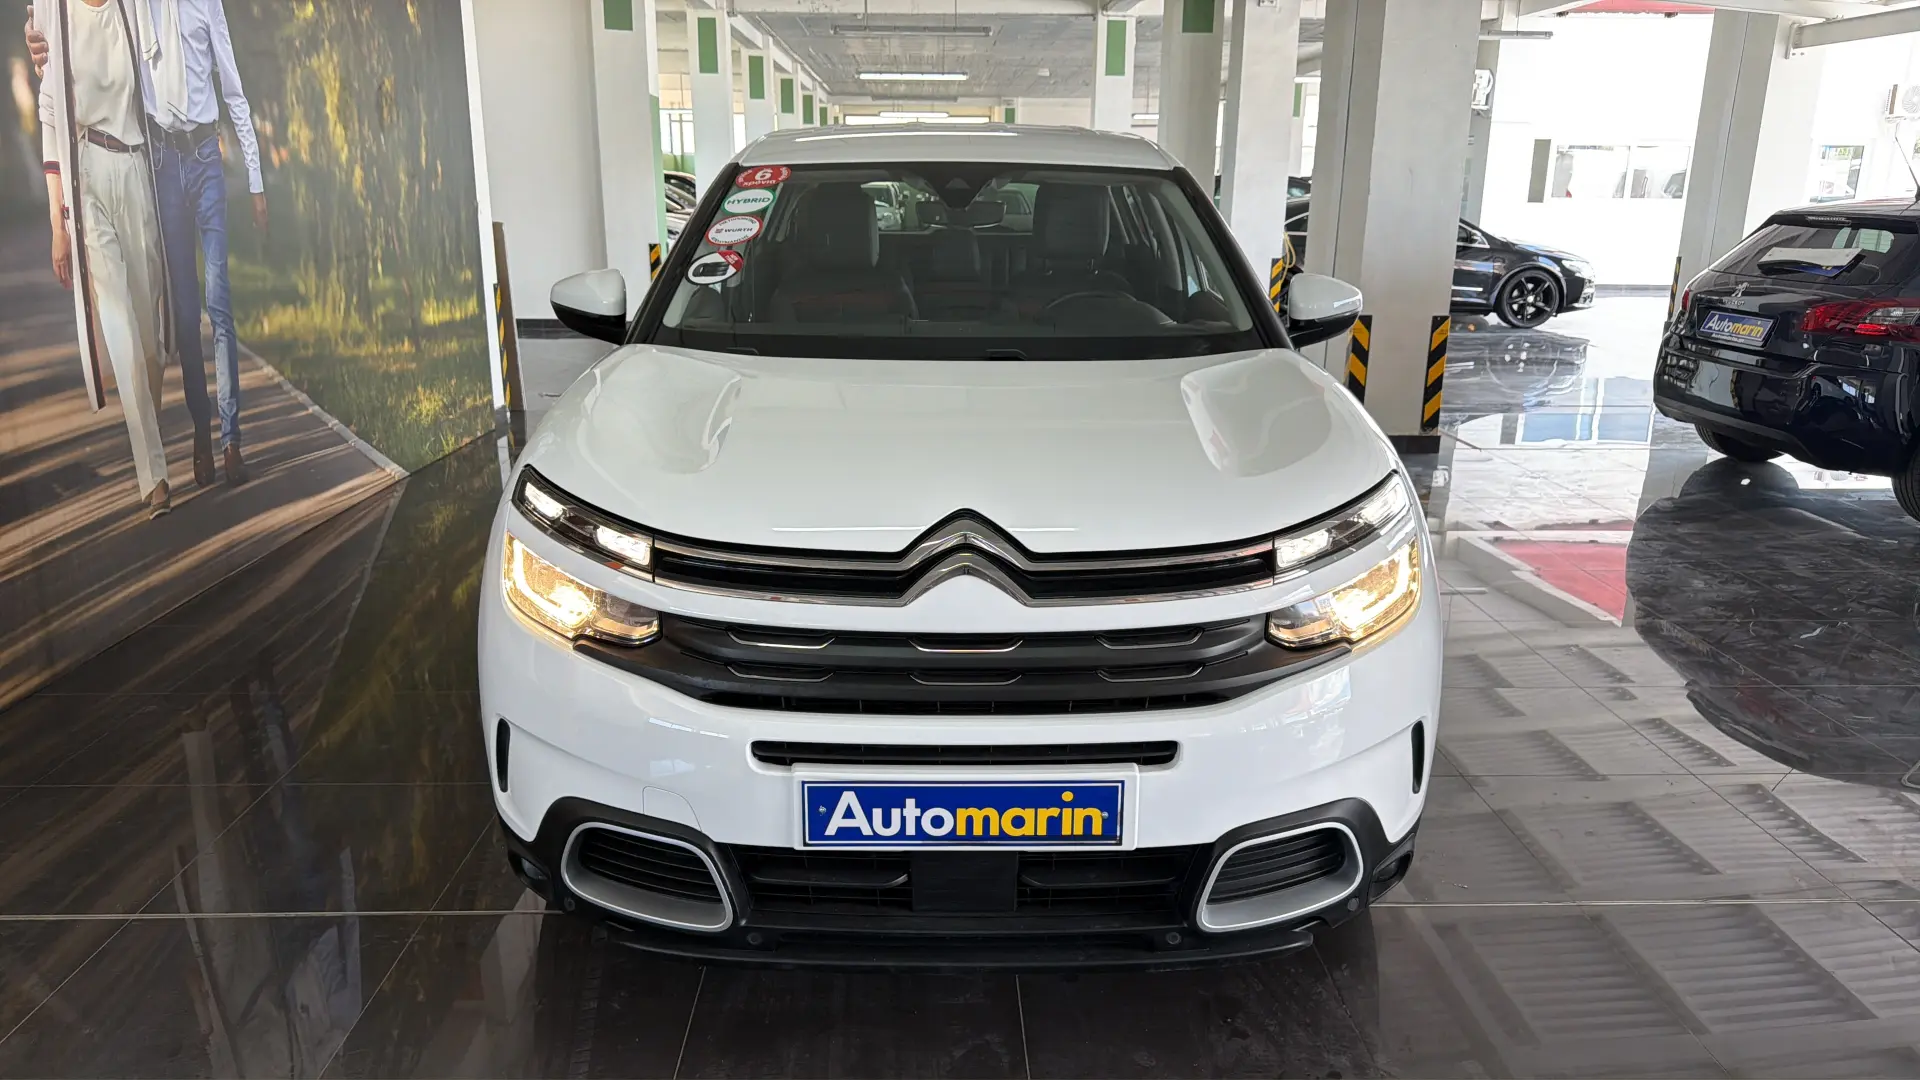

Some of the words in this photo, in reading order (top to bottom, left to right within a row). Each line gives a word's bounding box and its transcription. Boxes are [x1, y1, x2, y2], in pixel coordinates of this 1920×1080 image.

[755, 168, 773, 181] 6
[1705, 314, 1764, 338] Automarin
[824, 790, 1103, 837] Automarin
